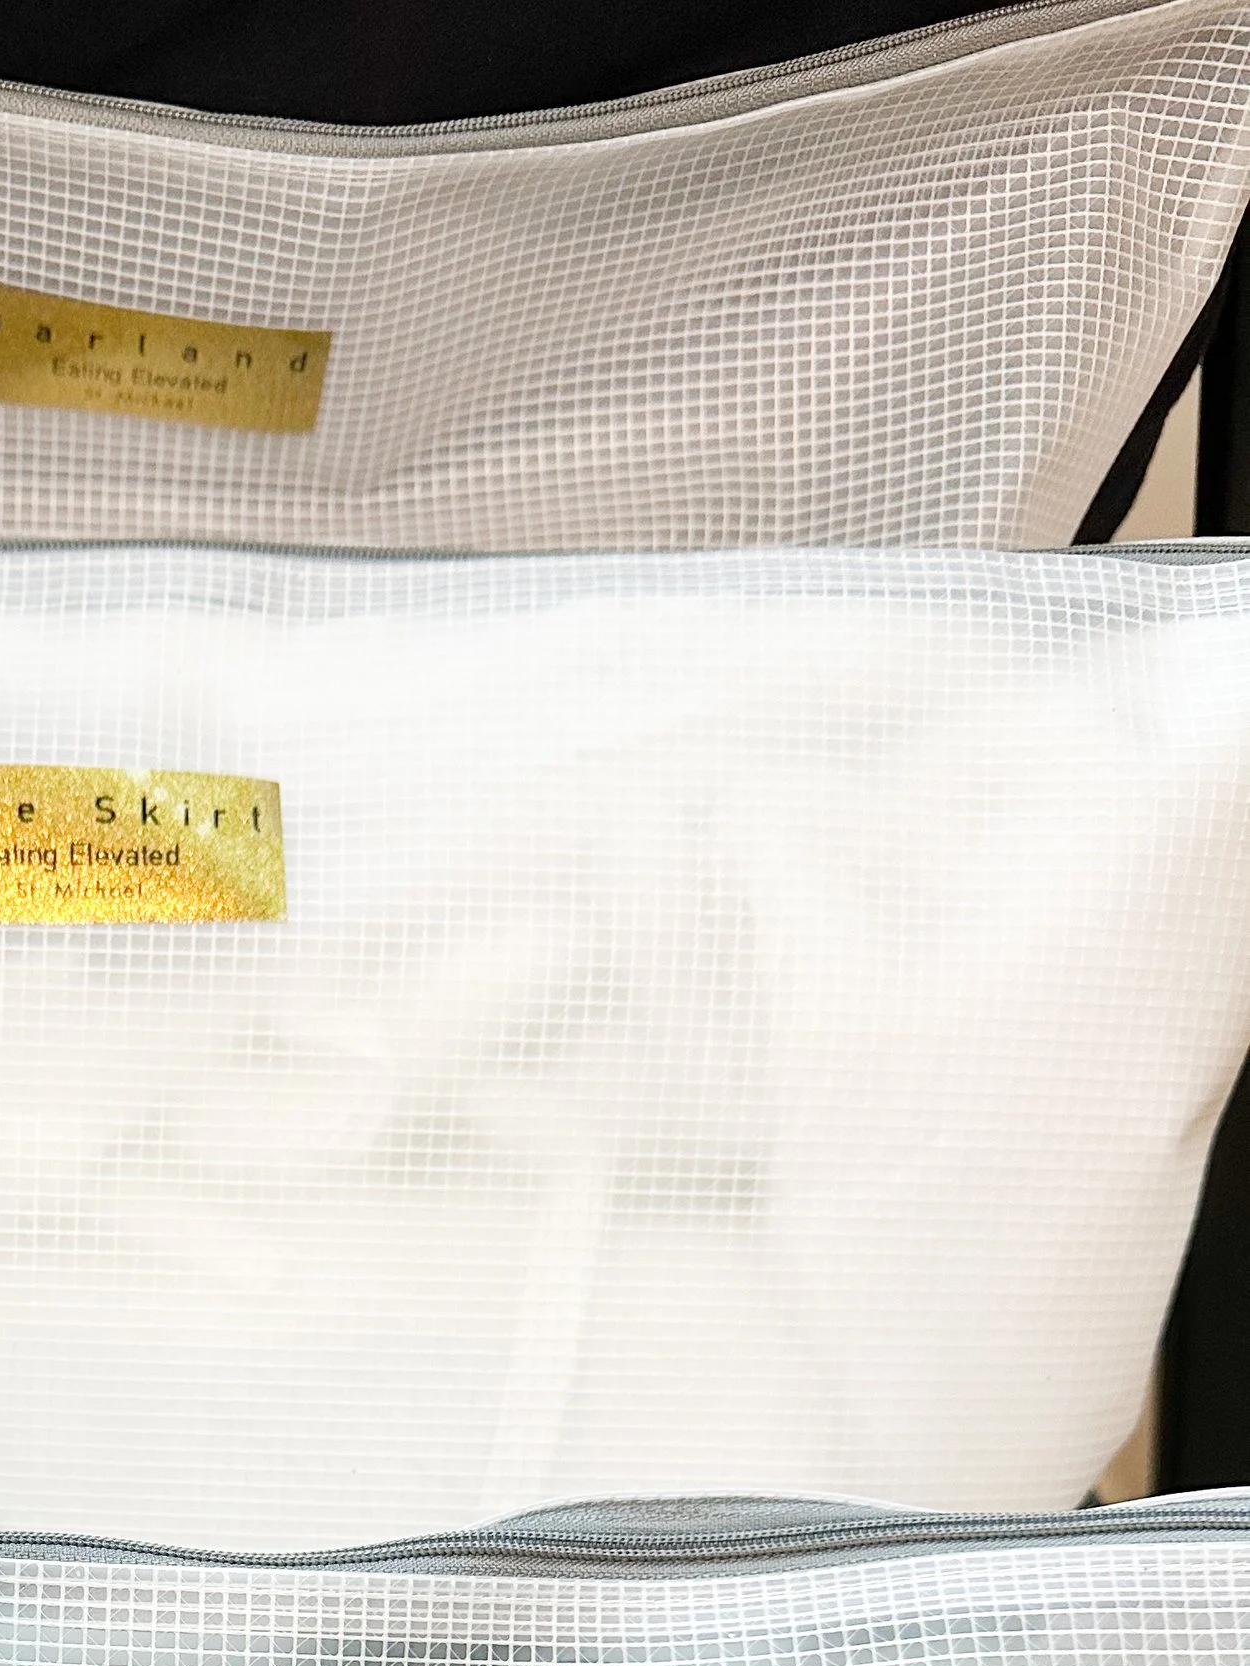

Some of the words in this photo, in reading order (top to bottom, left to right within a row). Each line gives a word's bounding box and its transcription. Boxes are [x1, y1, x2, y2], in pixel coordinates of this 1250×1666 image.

[131, 366, 229, 395] Elevated
[95, 795, 261, 833] Skirt
[71, 842, 180, 867] Elevated
[54, 879, 142, 898] Michael
